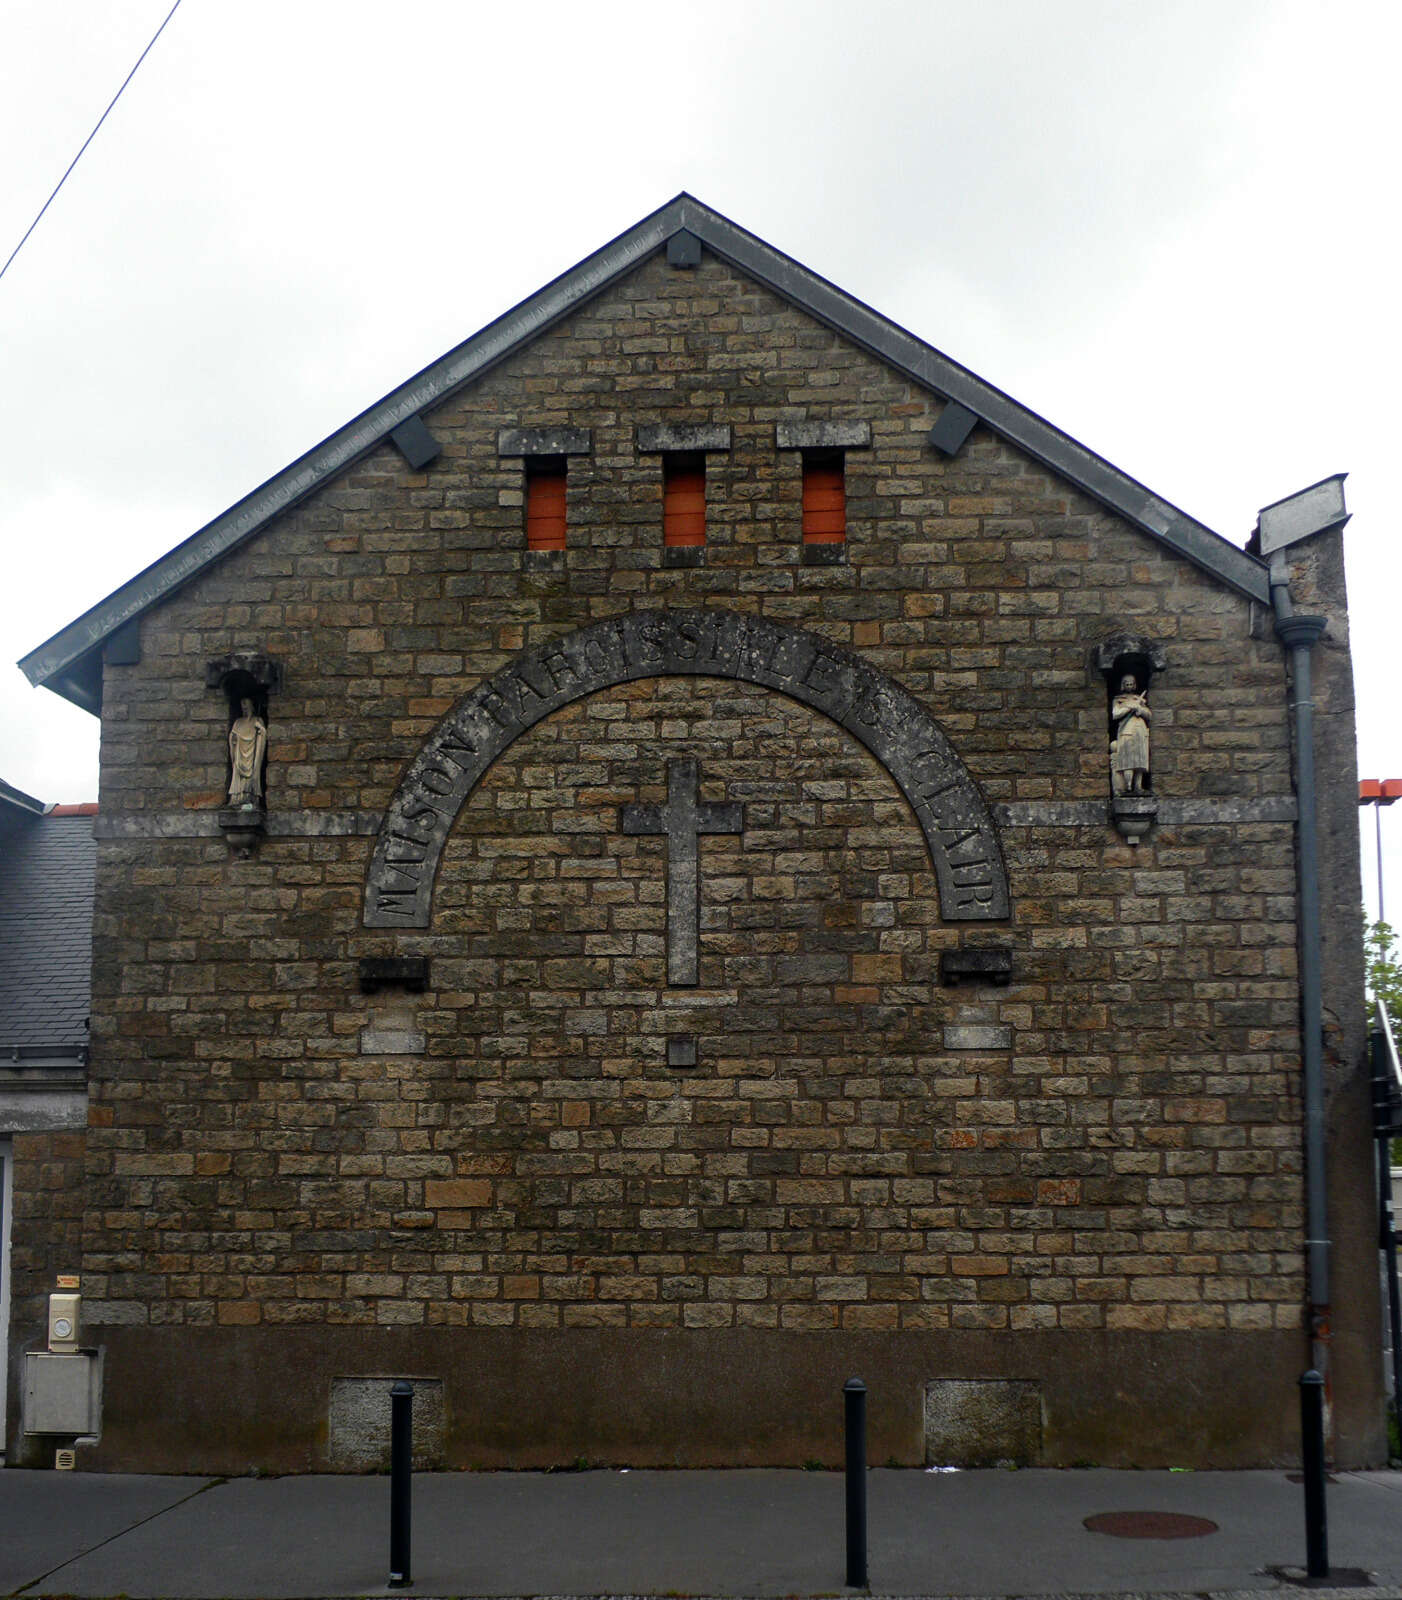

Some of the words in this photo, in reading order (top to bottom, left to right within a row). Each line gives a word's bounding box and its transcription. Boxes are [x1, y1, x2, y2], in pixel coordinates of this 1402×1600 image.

[376, 729, 479, 917] MAISON
[477, 621, 842, 730] PAROISSIALE
[910, 750, 996, 909] CLAIR
